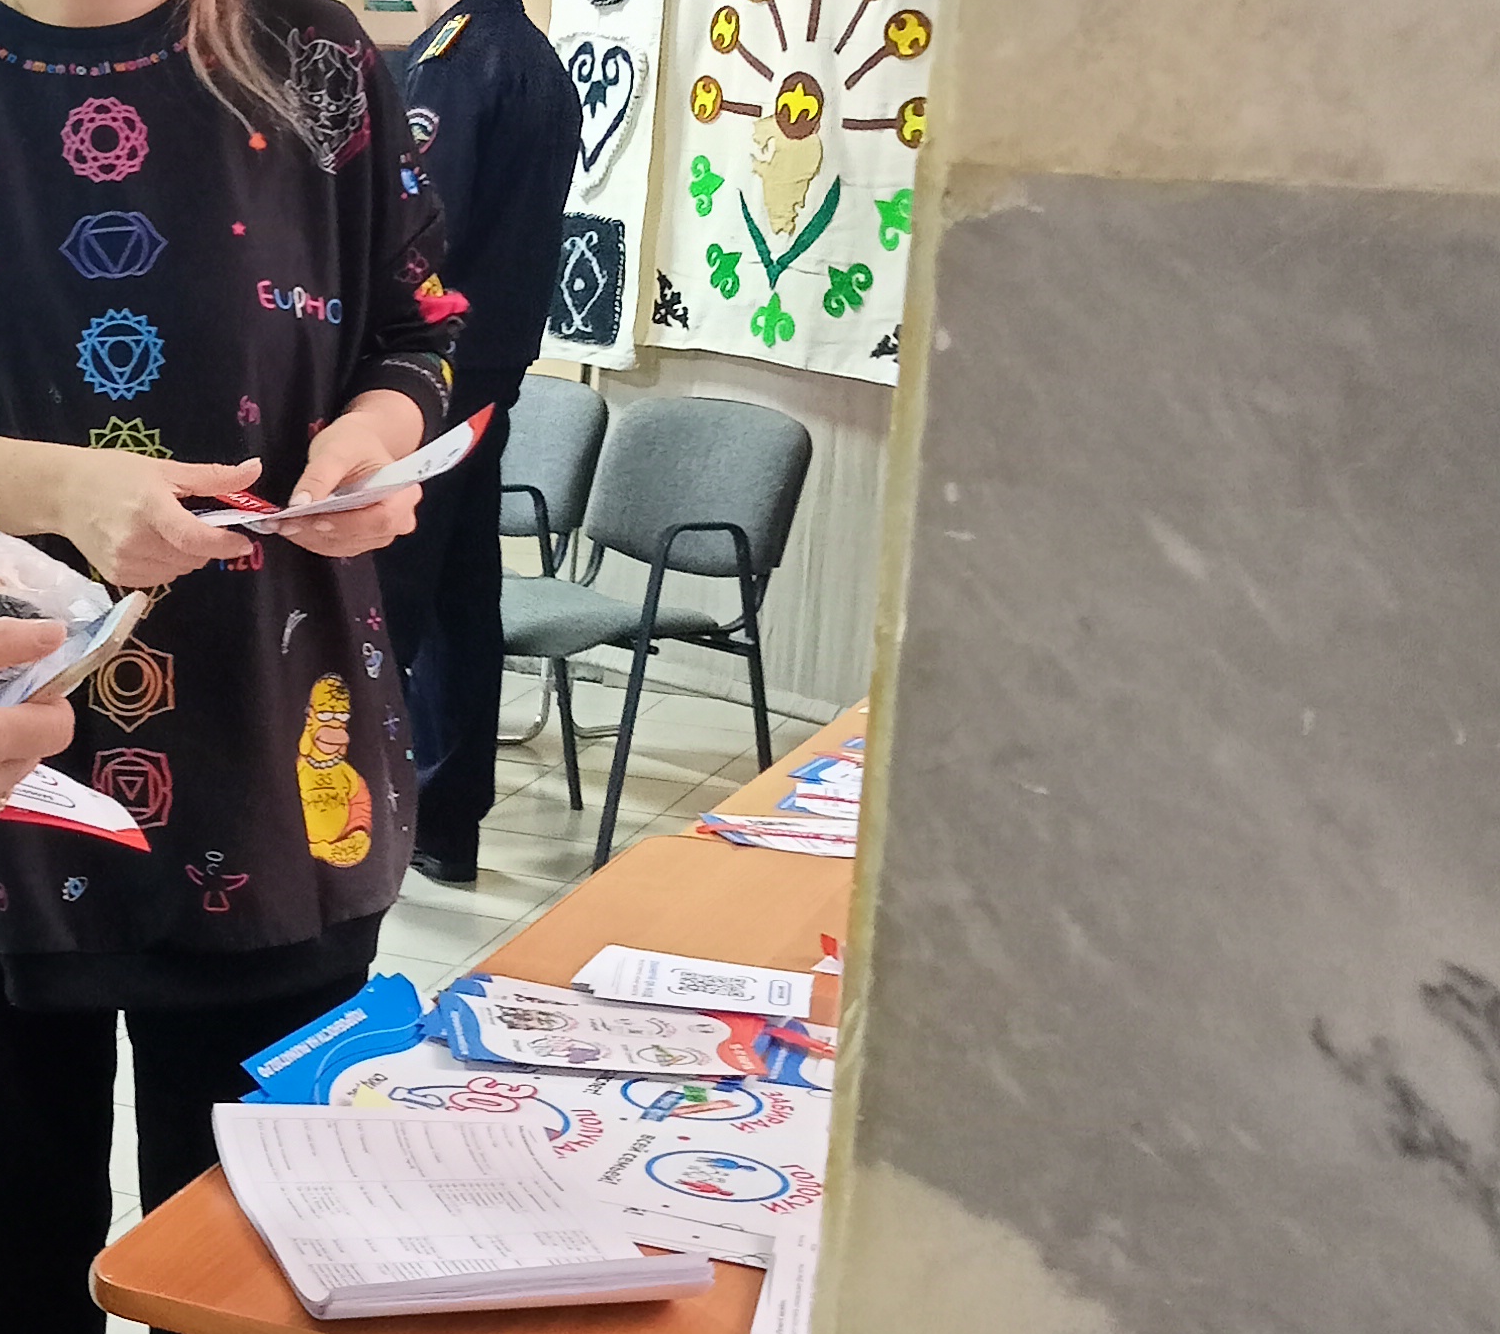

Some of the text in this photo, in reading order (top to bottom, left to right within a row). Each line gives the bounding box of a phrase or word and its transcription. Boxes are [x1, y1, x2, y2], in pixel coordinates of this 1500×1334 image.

[445, 1076, 538, 1113] 30
[730, 1090, 795, 1134] ЗАБИРАЙ
[759, 1164, 823, 1215] ГОЛОСУЙ
